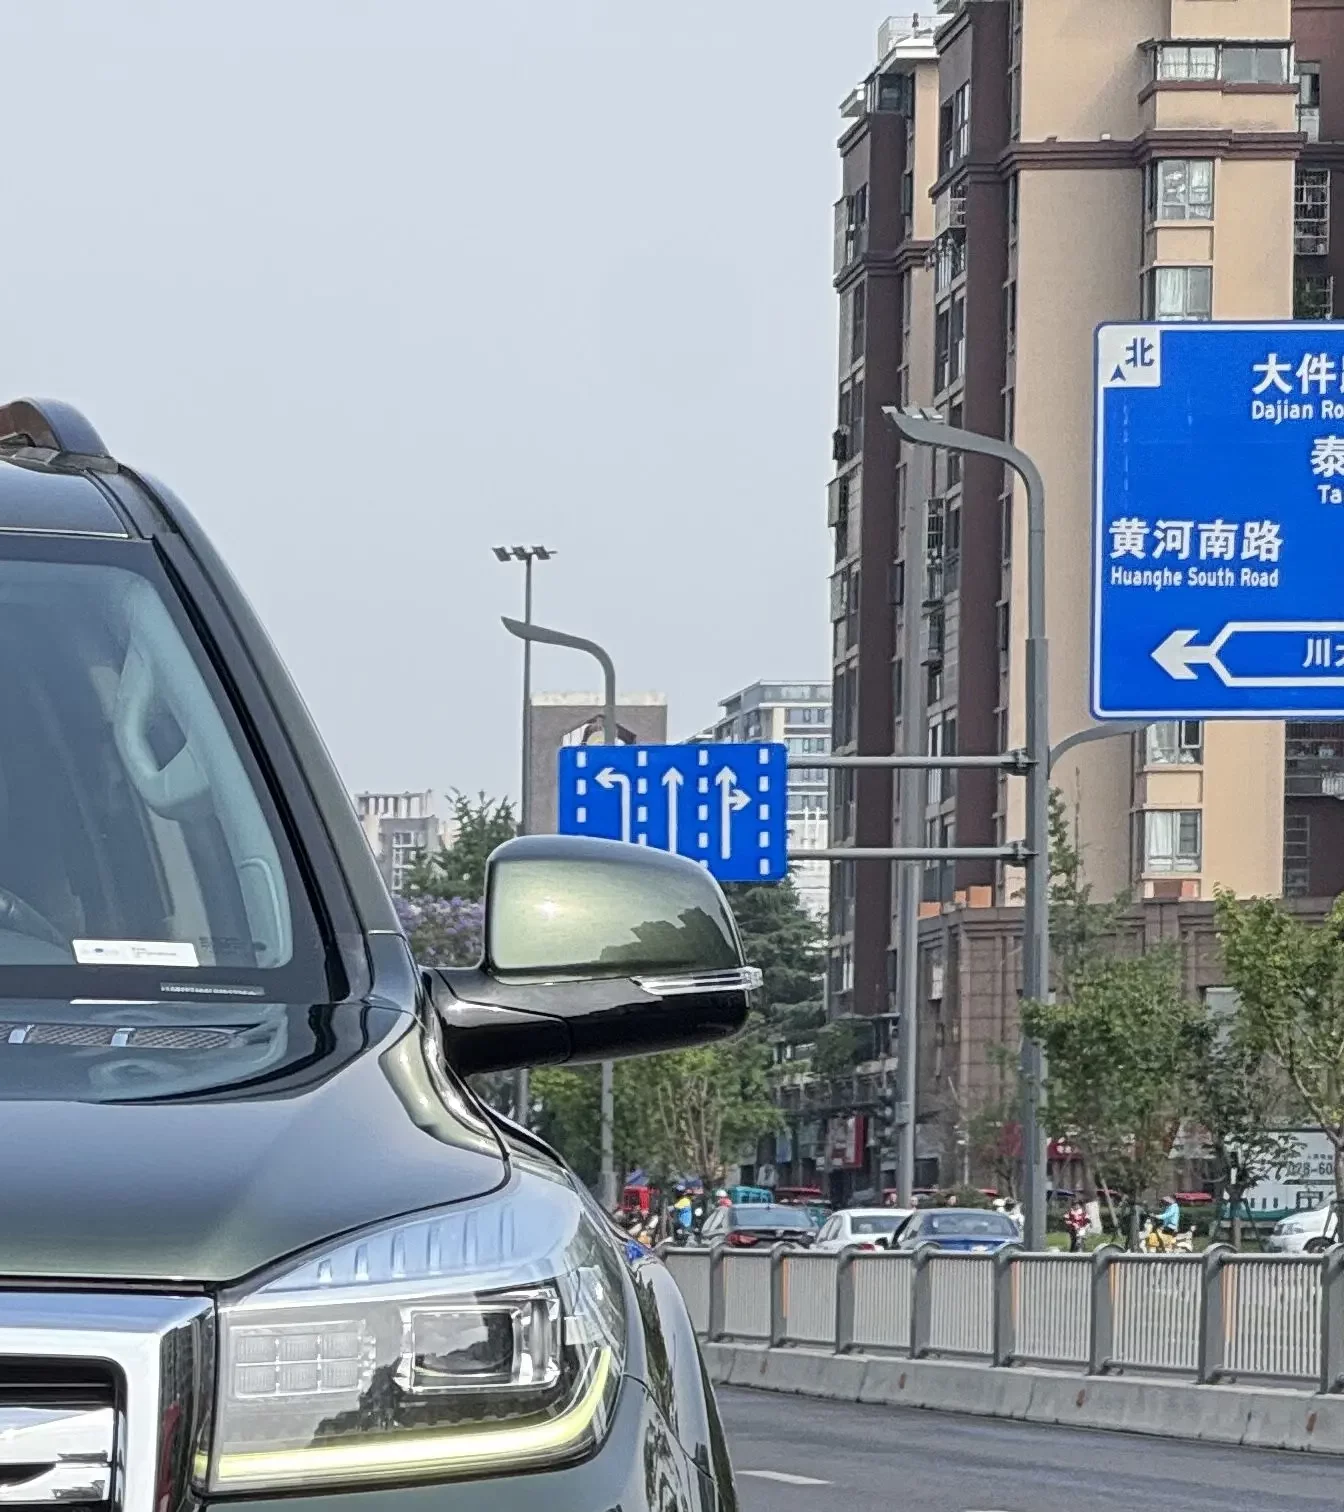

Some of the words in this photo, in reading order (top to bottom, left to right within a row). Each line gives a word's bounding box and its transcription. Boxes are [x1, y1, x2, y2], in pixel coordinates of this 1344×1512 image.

[1125, 337, 1154, 367] 北
[1252, 353, 1344, 394] 大件
[1252, 400, 1313, 425] Dajian
[1109, 518, 1283, 562] 黄河南路
[1111, 566, 1182, 592] Huanghe
[1187, 566, 1235, 587] South
[1240, 567, 1279, 588] Road
